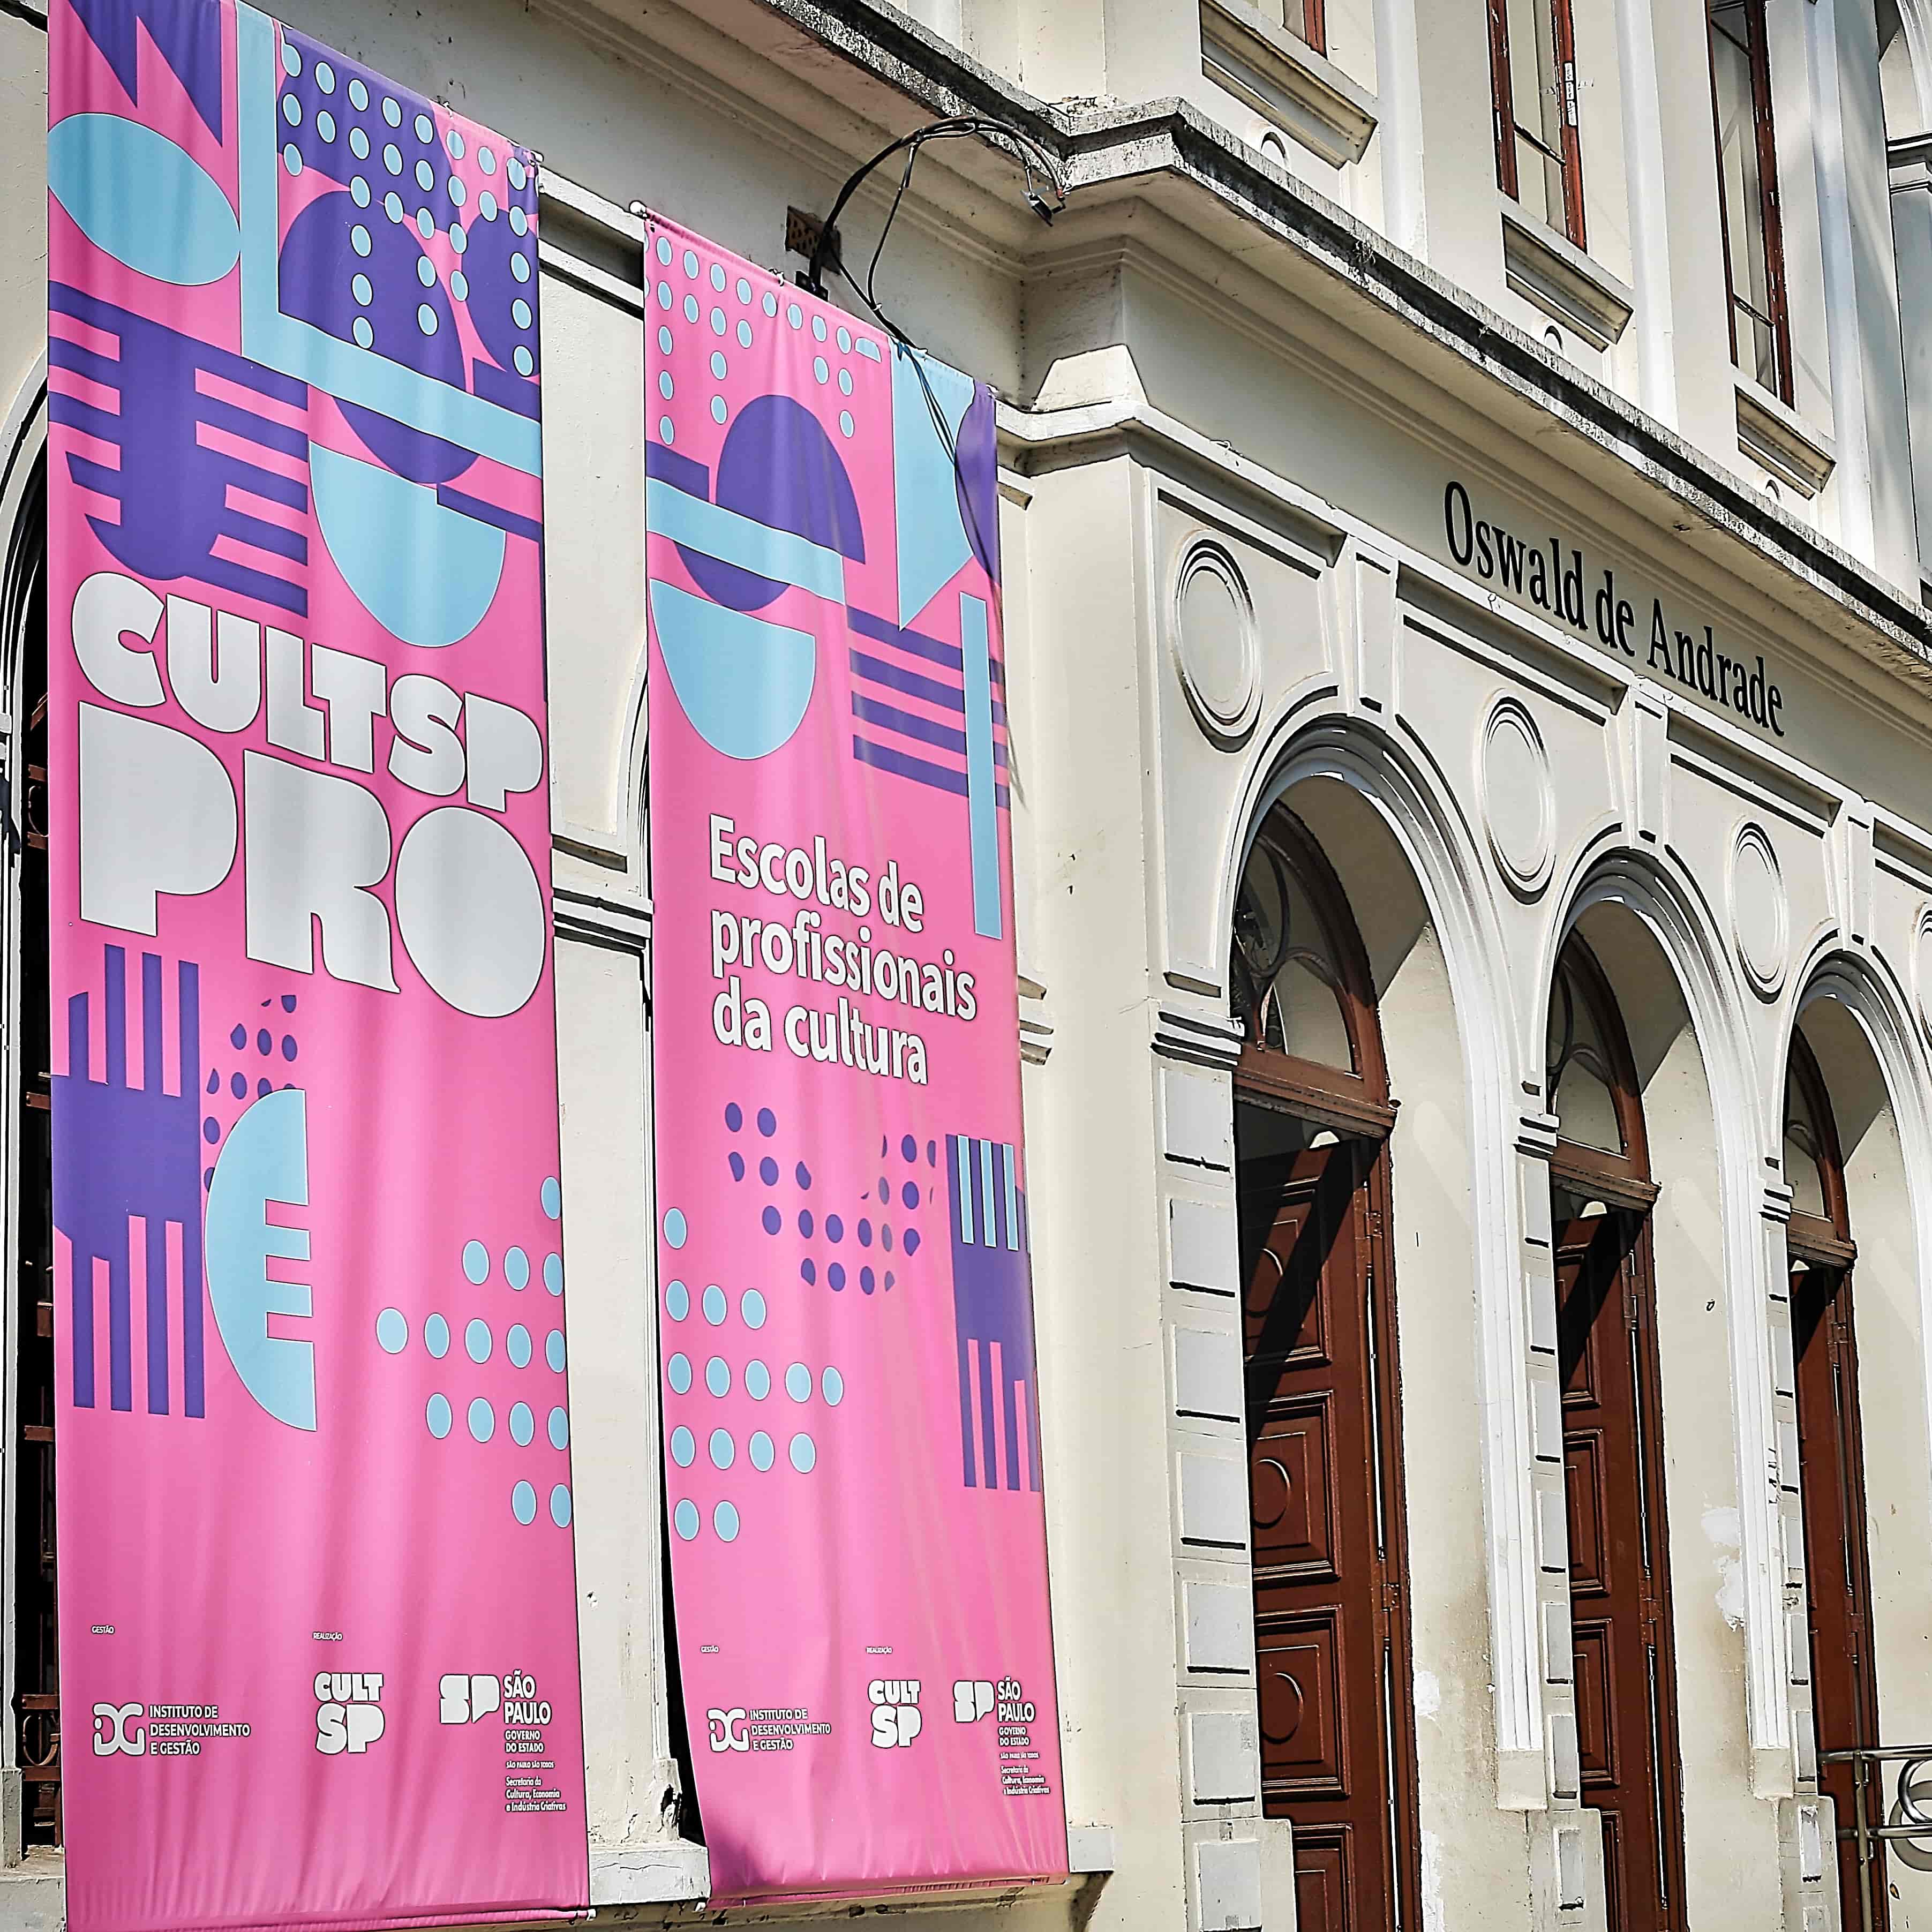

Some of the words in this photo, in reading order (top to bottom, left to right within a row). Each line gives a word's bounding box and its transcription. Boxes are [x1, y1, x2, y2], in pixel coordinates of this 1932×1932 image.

[1445, 481, 1588, 630] Oswald
[1596, 570, 1635, 657] de
[1647, 599, 1785, 736] Andrade
[79, 701, 545, 1018] PRO
[710, 814, 870, 917] Escolas
[878, 860, 923, 933] de
[711, 909, 976, 1020] profissionais
[713, 976, 772, 1051] da
[784, 998, 927, 1085] cultura
[92, 1625, 115, 1634] GESTÃO
[313, 1632, 343, 1641] REALIZAÇÃO
[314, 1673, 383, 1702] CULT
[503, 1670, 535, 1698] SÃO
[998, 1677, 1021, 1700] SÃO
[440, 1675, 500, 1723] SP
[868, 1680, 920, 1704] CULT
[953, 1681, 994, 1722] SP
[149, 1705, 202, 1719] INSTITUTO
[204, 1705, 218, 1719] DE
[505, 1702, 551, 1724] PAULO
[750, 1710, 792, 1720] INSTITUTO
[794, 1709, 808, 1719] DE
[998, 1703, 1035, 1722] PAULO
[150, 1724, 250, 1737] DESENVOLVIMENTO
[316, 1703, 385, 1754] SP
[751, 1724, 831, 1735] DESENVOLVIMENTO
[871, 1705, 922, 1748] SP
[999, 1726, 1026, 1735] GOVERNO
[506, 1730, 540, 1740] GOVERNO
[1000, 1737, 1009, 1746] DO
[1011, 1737, 1029, 1745] ESTADO
[151, 1743, 157, 1755] E
[160, 1740, 200, 1755] GESTÃO
[506, 1742, 516, 1752] DO
[518, 1742, 544, 1752] ESTADO
[753, 1740, 758, 1750] E
[760, 1738, 793, 1750] GESTÃO
[507, 1760, 516, 1768] SÃO
[532, 1760, 540, 1768] SÃO
[506, 1777, 533, 1786] Secretaria
[535, 1776, 541, 1786] da
[506, 1788, 532, 1800] Cultura,
[533, 1788, 560, 1798] Economia
[512, 1800, 539, 1811] Indústria
[540, 1801, 566, 1810] Criativas
